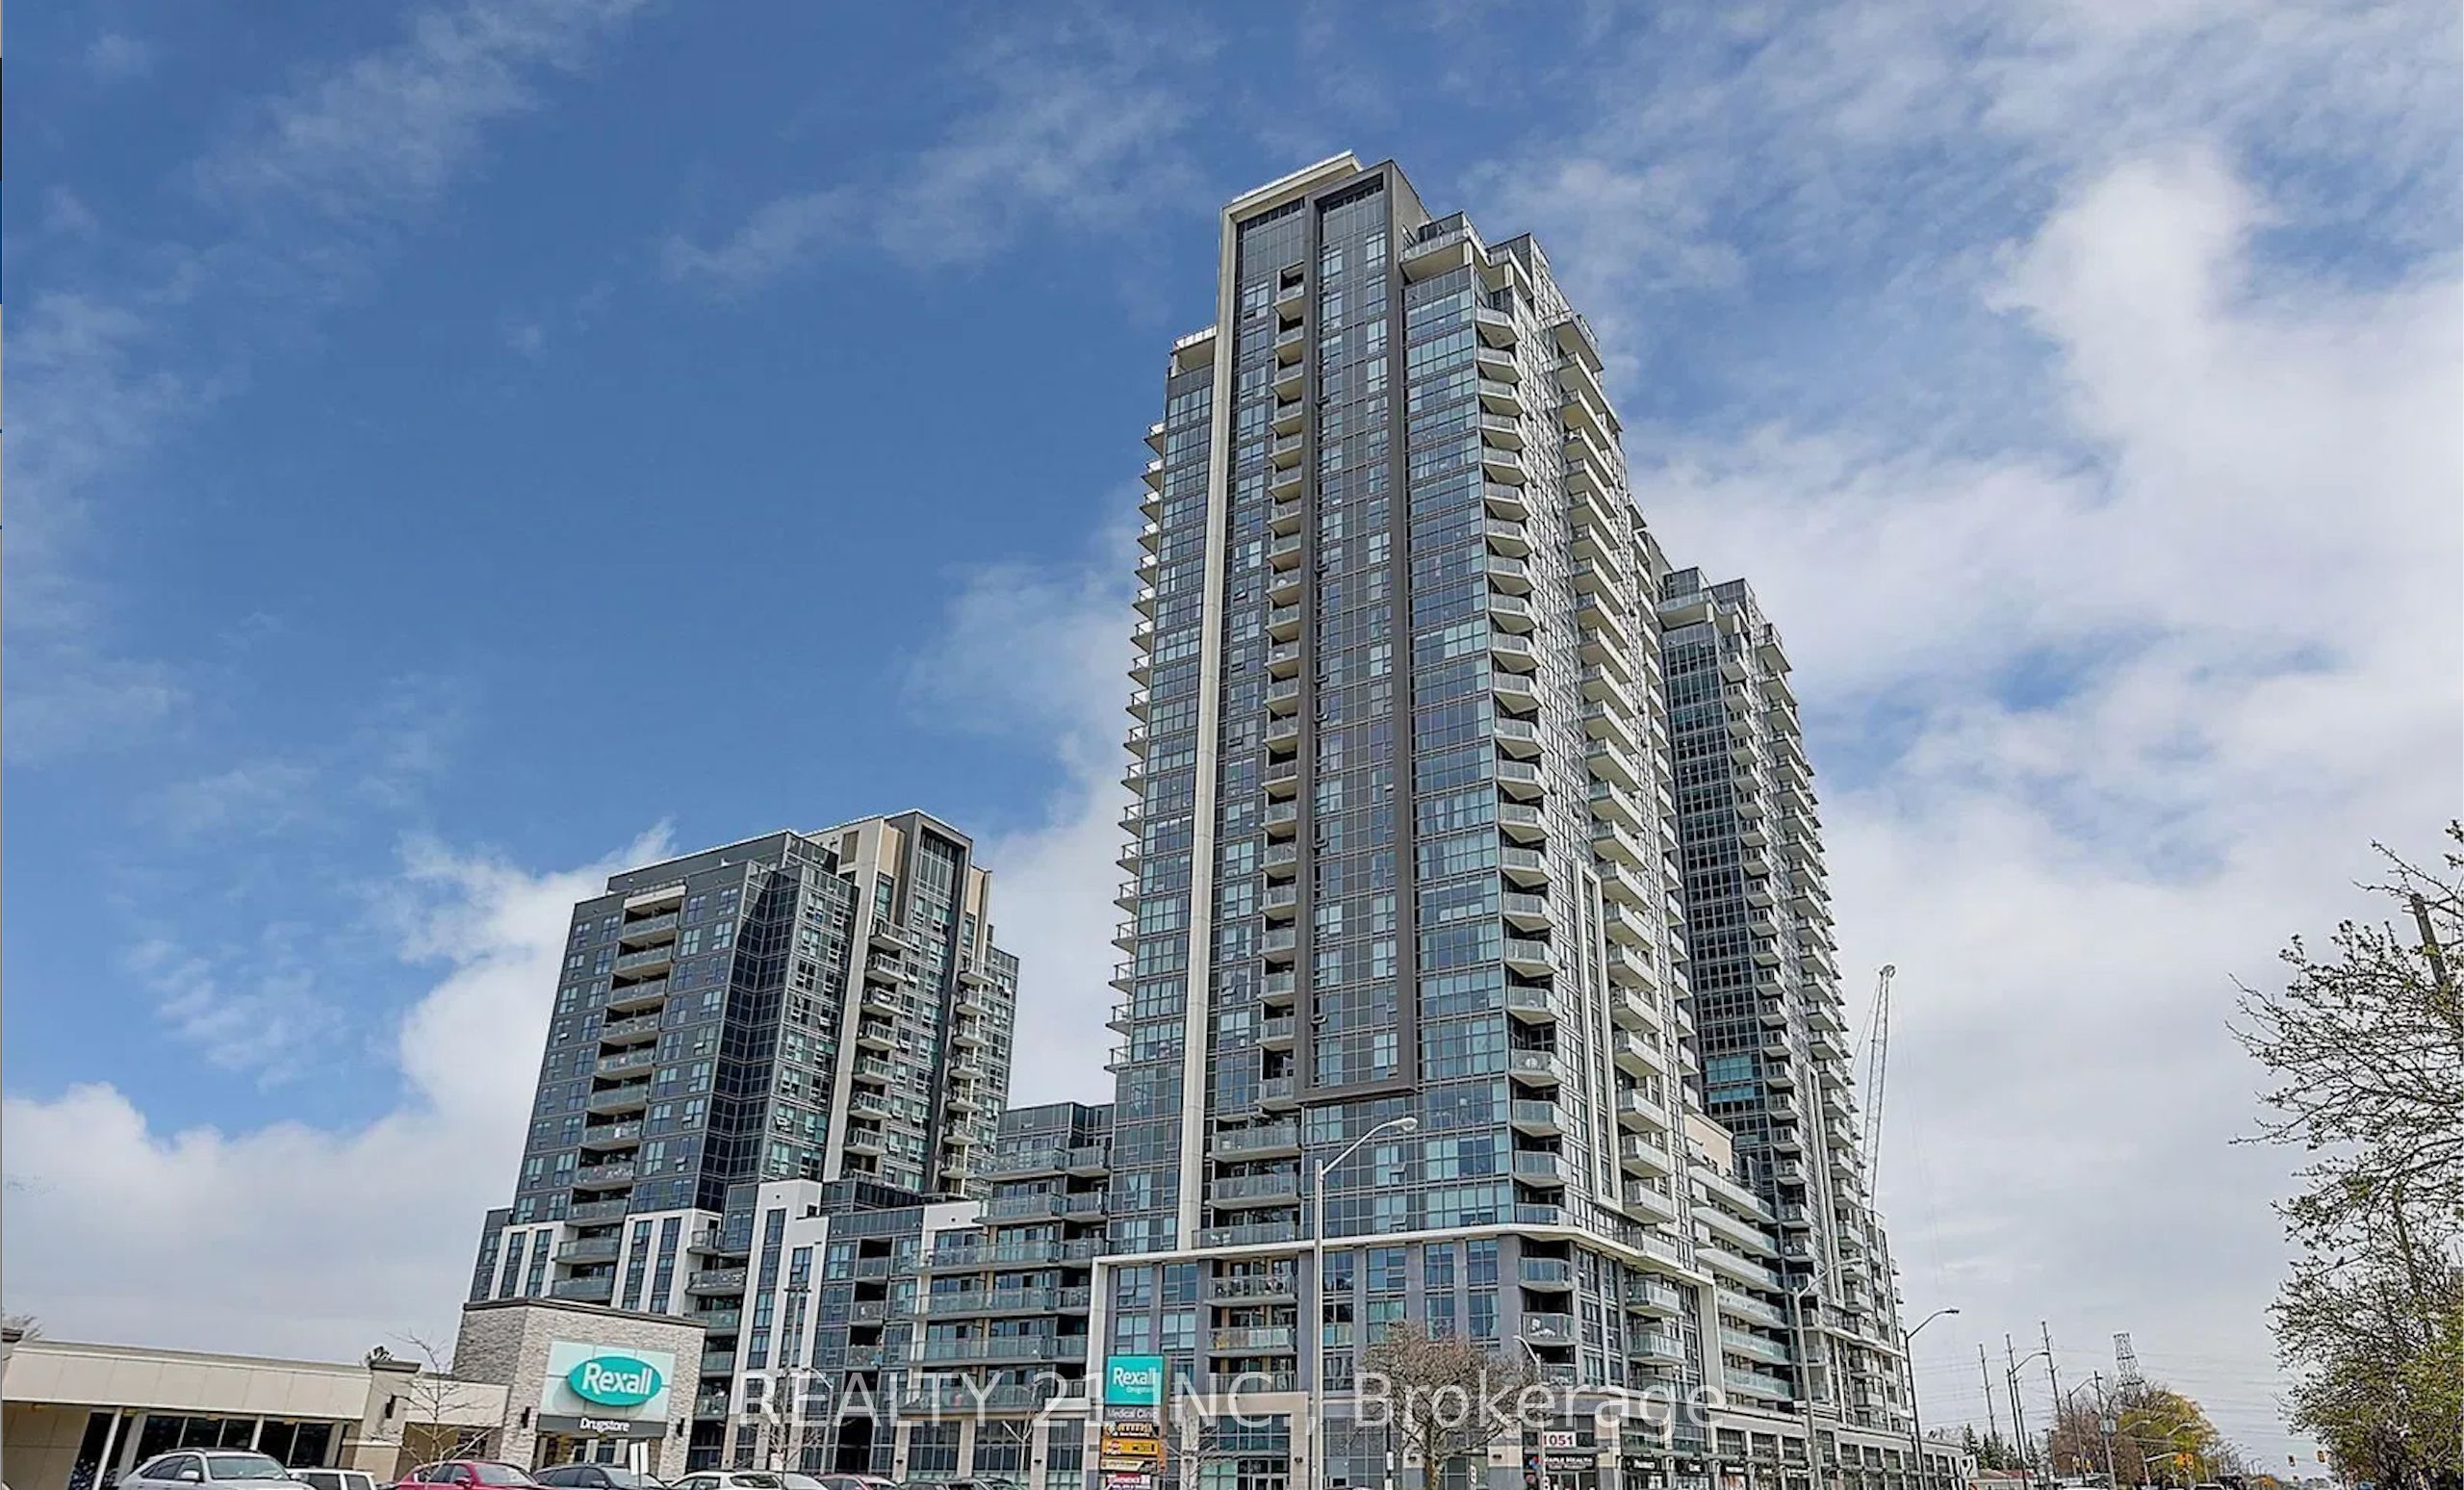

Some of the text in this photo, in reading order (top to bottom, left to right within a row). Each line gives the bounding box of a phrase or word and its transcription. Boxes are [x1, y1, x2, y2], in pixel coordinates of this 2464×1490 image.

[581, 1362, 653, 1395] Rexall
[1113, 1367, 1157, 1387] Rexall
[579, 1417, 630, 1433] Drugstore
[1543, 1434, 1574, 1446] 1051
